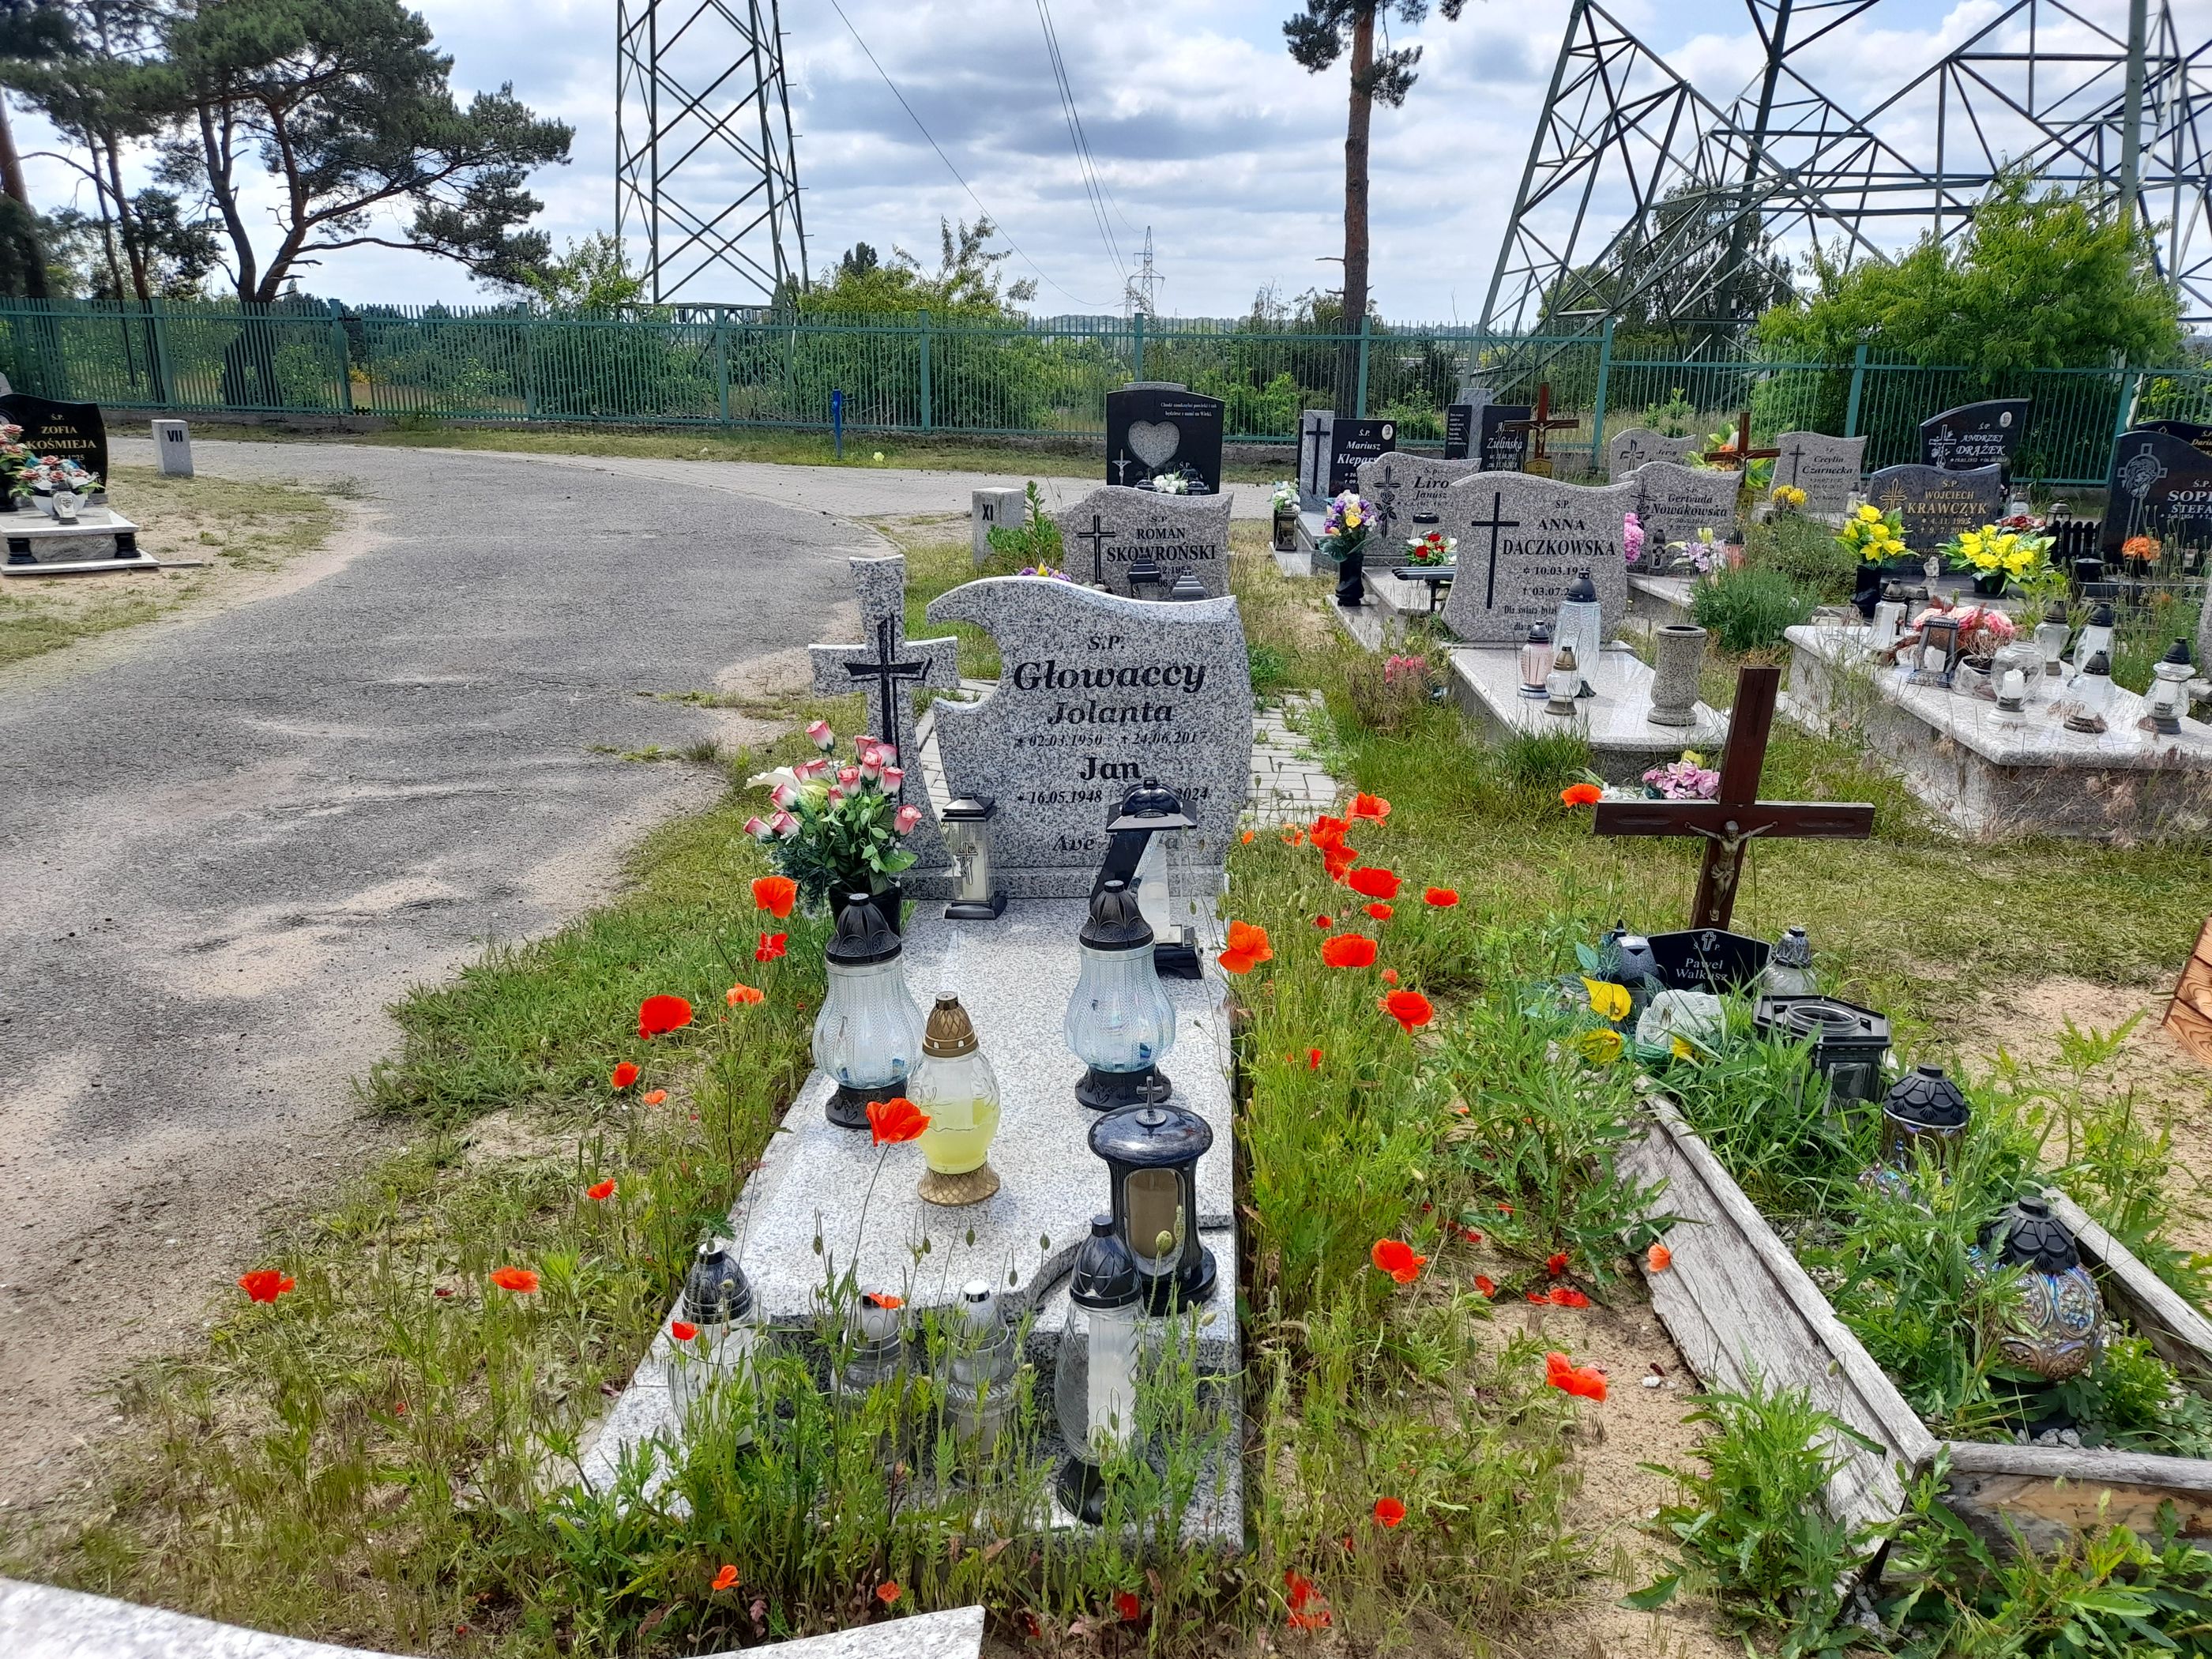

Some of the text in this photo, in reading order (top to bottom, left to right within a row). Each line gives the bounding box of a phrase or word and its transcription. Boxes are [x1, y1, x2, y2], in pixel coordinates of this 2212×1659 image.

[167, 429, 183, 442] VII
[26, 437, 96, 450] KOŚMIEJA
[1345, 441, 1381, 450] Mariusz
[1955, 443, 2006, 457] DRĄŻEK
[1802, 465, 1853, 474] Czarnecka
[1414, 476, 1450, 489] Liro
[1413, 490, 1447, 501] Janusz
[1668, 494, 1713, 504] Gertruda
[1925, 491, 1974, 499] WOJCIECH
[982, 504, 993, 521] XI
[1651, 503, 1727, 517] Nowakowska
[1907, 502, 1988, 514] KRAWCZYK
[1538, 519, 1586, 531] ANNA
[1136, 528, 1186, 540] ROMAN
[1107, 541, 1216, 562] SKOWROŃSKI
[1503, 540, 1616, 556] DACZKOWSKA
[1014, 660, 1206, 693] Głowaccy
[1048, 701, 1173, 724] Jolanta
[1029, 734, 1103, 747] 02.03.1950
[1080, 757, 1142, 781] Jan
[1030, 790, 1103, 804] 16.05.1948
[1054, 834, 1095, 851] Ave
